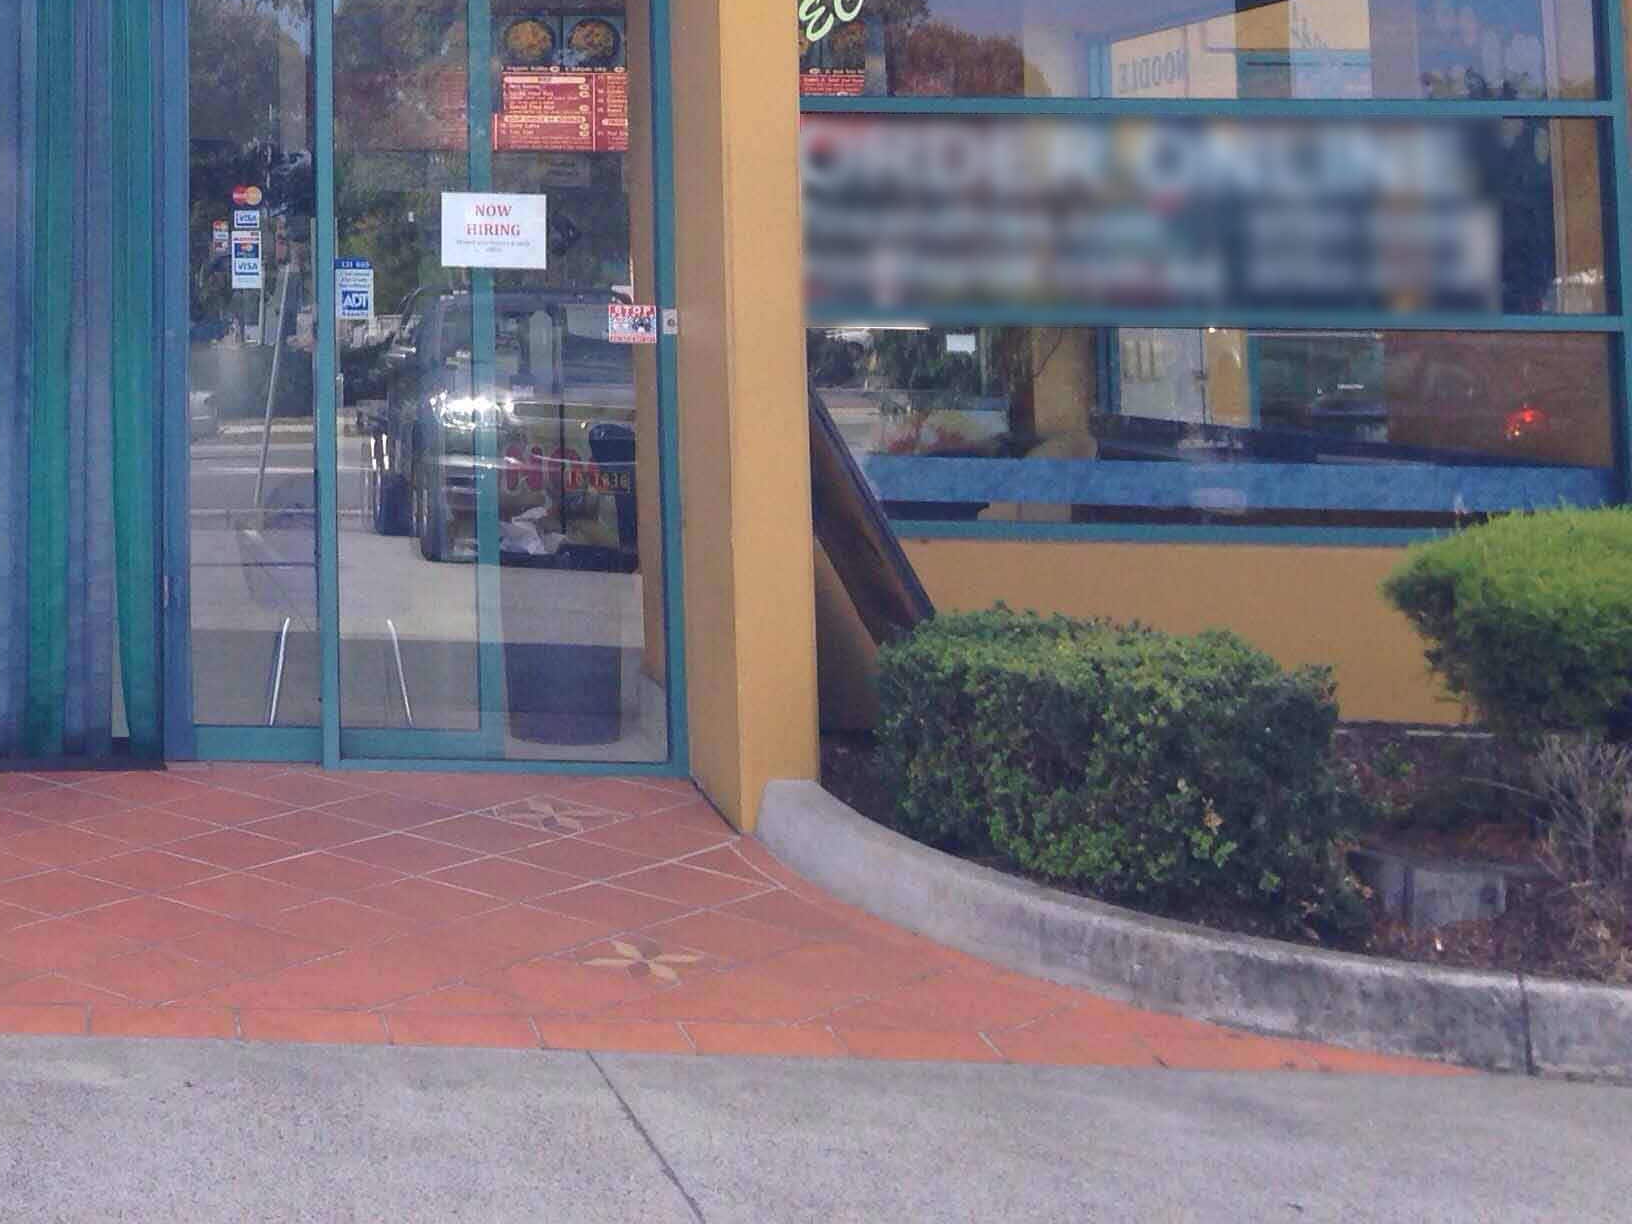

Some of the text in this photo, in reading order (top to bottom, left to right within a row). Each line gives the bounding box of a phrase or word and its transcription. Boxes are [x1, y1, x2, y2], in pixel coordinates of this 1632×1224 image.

[475, 204, 512, 217] NOW
[466, 223, 520, 236] HIRING
[343, 293, 368, 308] ADT
